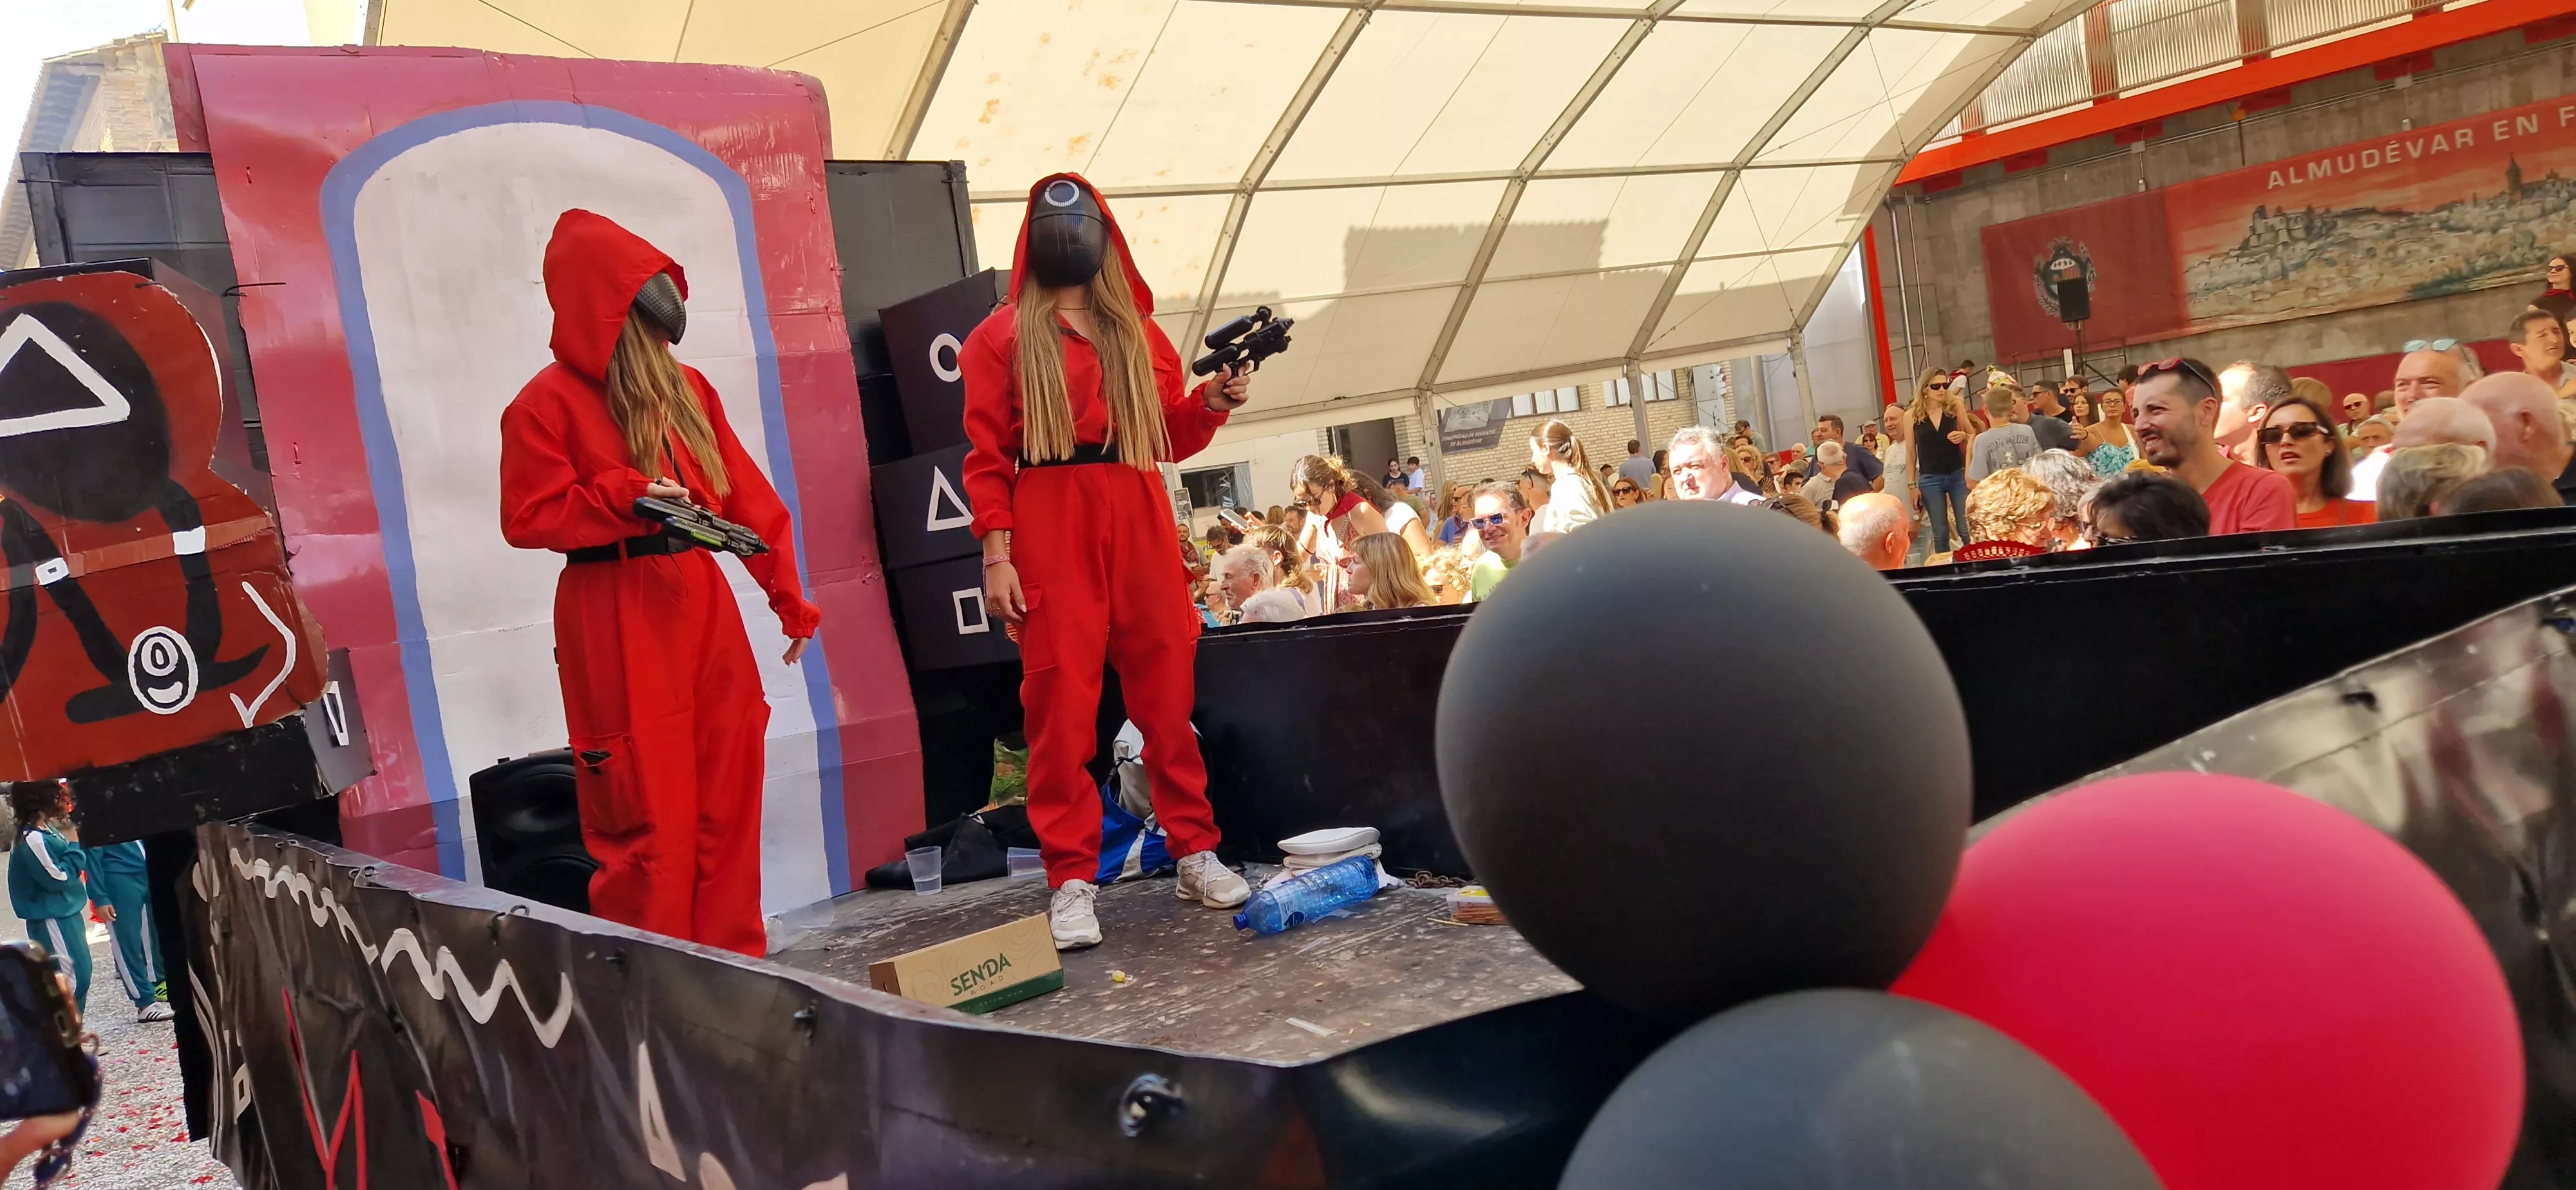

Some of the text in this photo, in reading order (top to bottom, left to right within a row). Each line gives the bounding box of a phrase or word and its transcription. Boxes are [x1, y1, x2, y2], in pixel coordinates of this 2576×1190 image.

[2267, 128, 2474, 190] ALMUDÉVAR
[2492, 113, 2539, 141] EN
[1441, 433, 1468, 442] COMUNIDAD
[950, 952, 1013, 996] SENDA
